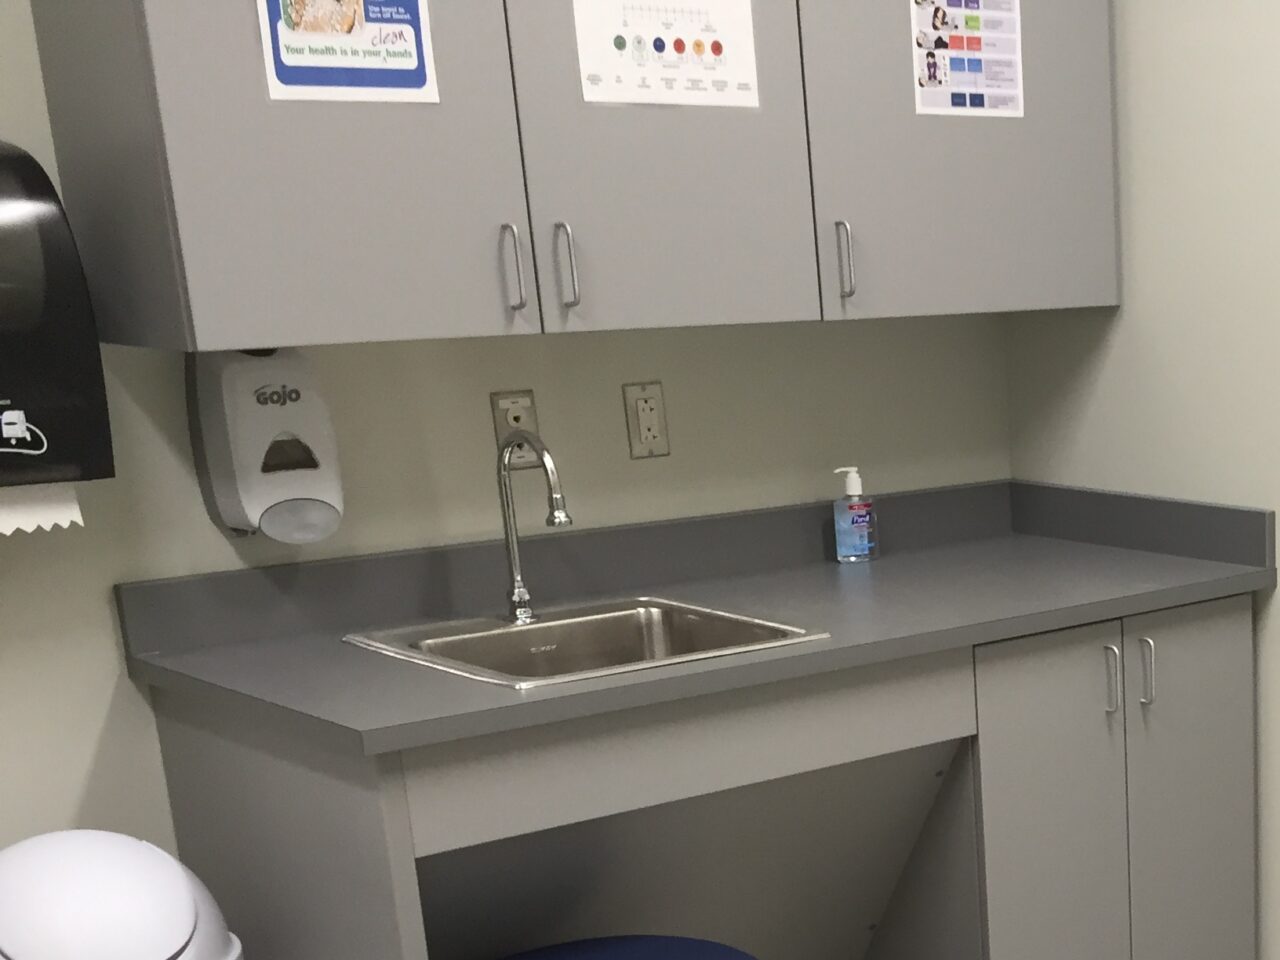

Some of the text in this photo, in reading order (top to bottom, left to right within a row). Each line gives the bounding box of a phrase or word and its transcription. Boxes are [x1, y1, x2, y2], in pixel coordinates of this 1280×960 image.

[371, 27, 408, 47] clean
[284, 44, 413, 61] Your health is in your hands
